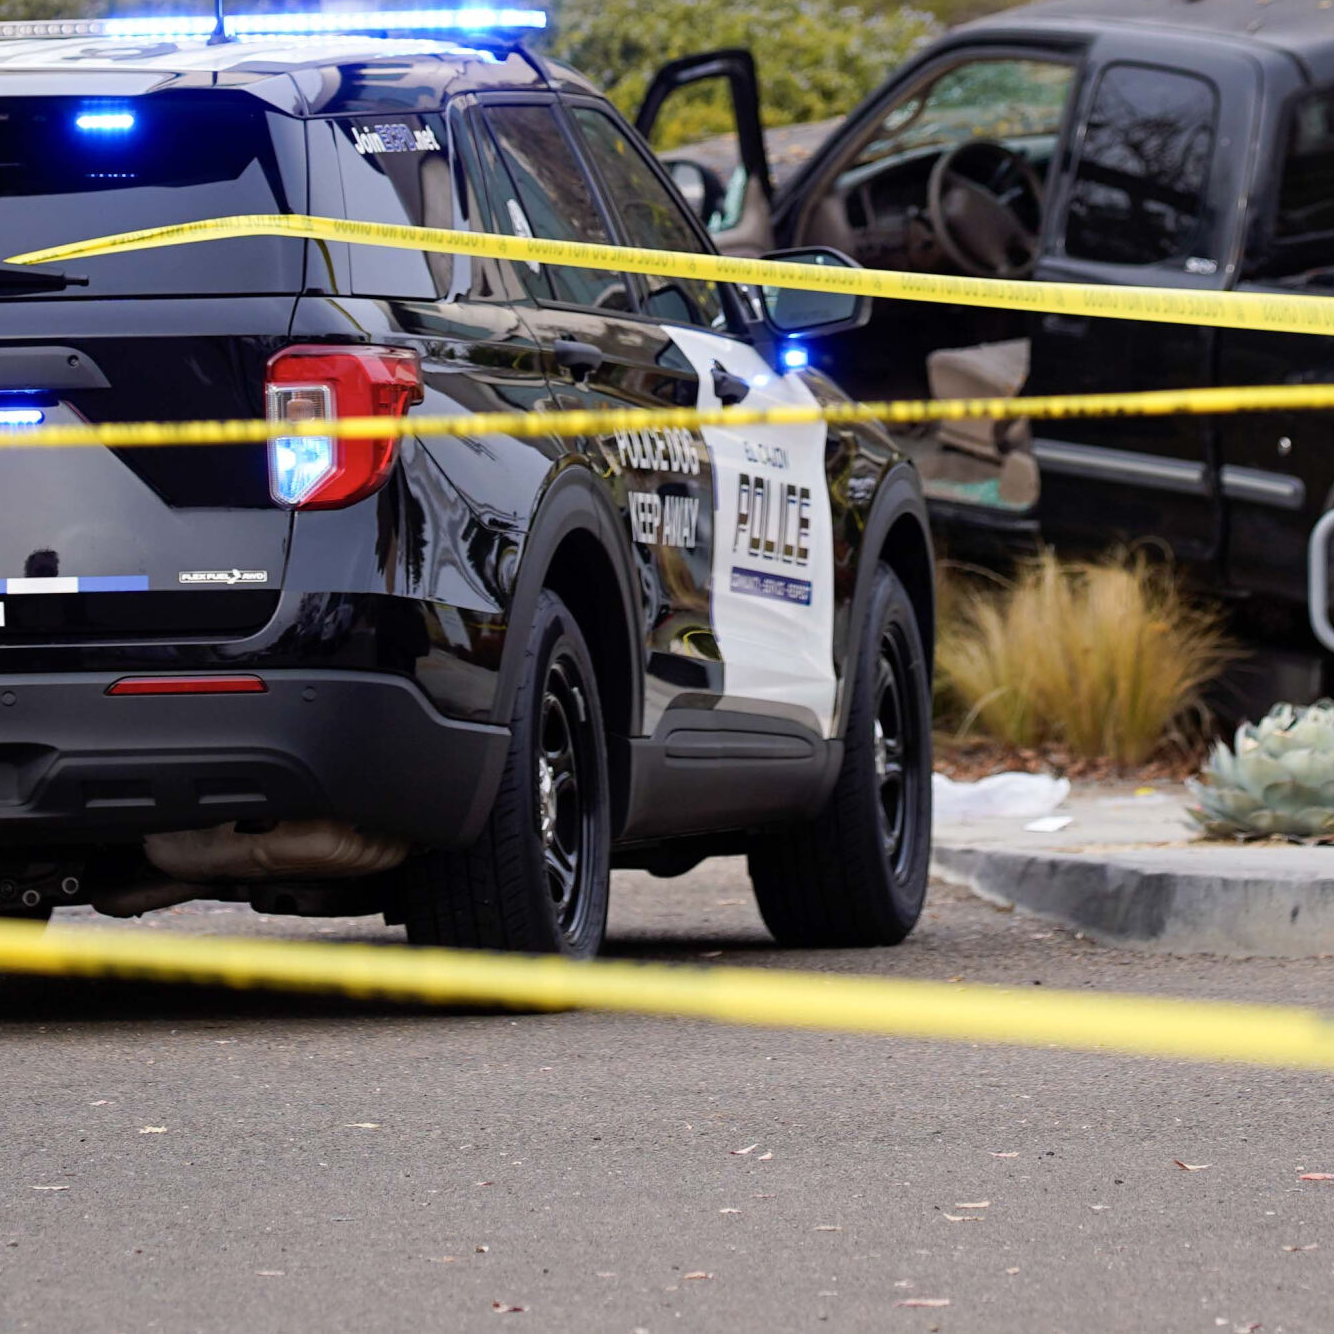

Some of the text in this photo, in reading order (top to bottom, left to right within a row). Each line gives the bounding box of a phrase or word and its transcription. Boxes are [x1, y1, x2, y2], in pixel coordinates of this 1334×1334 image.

[628, 491, 699, 549] KEEP AWAY
[733, 472, 811, 566] POLICE
[182, 572, 264, 581] FLEX FUEL AWD
